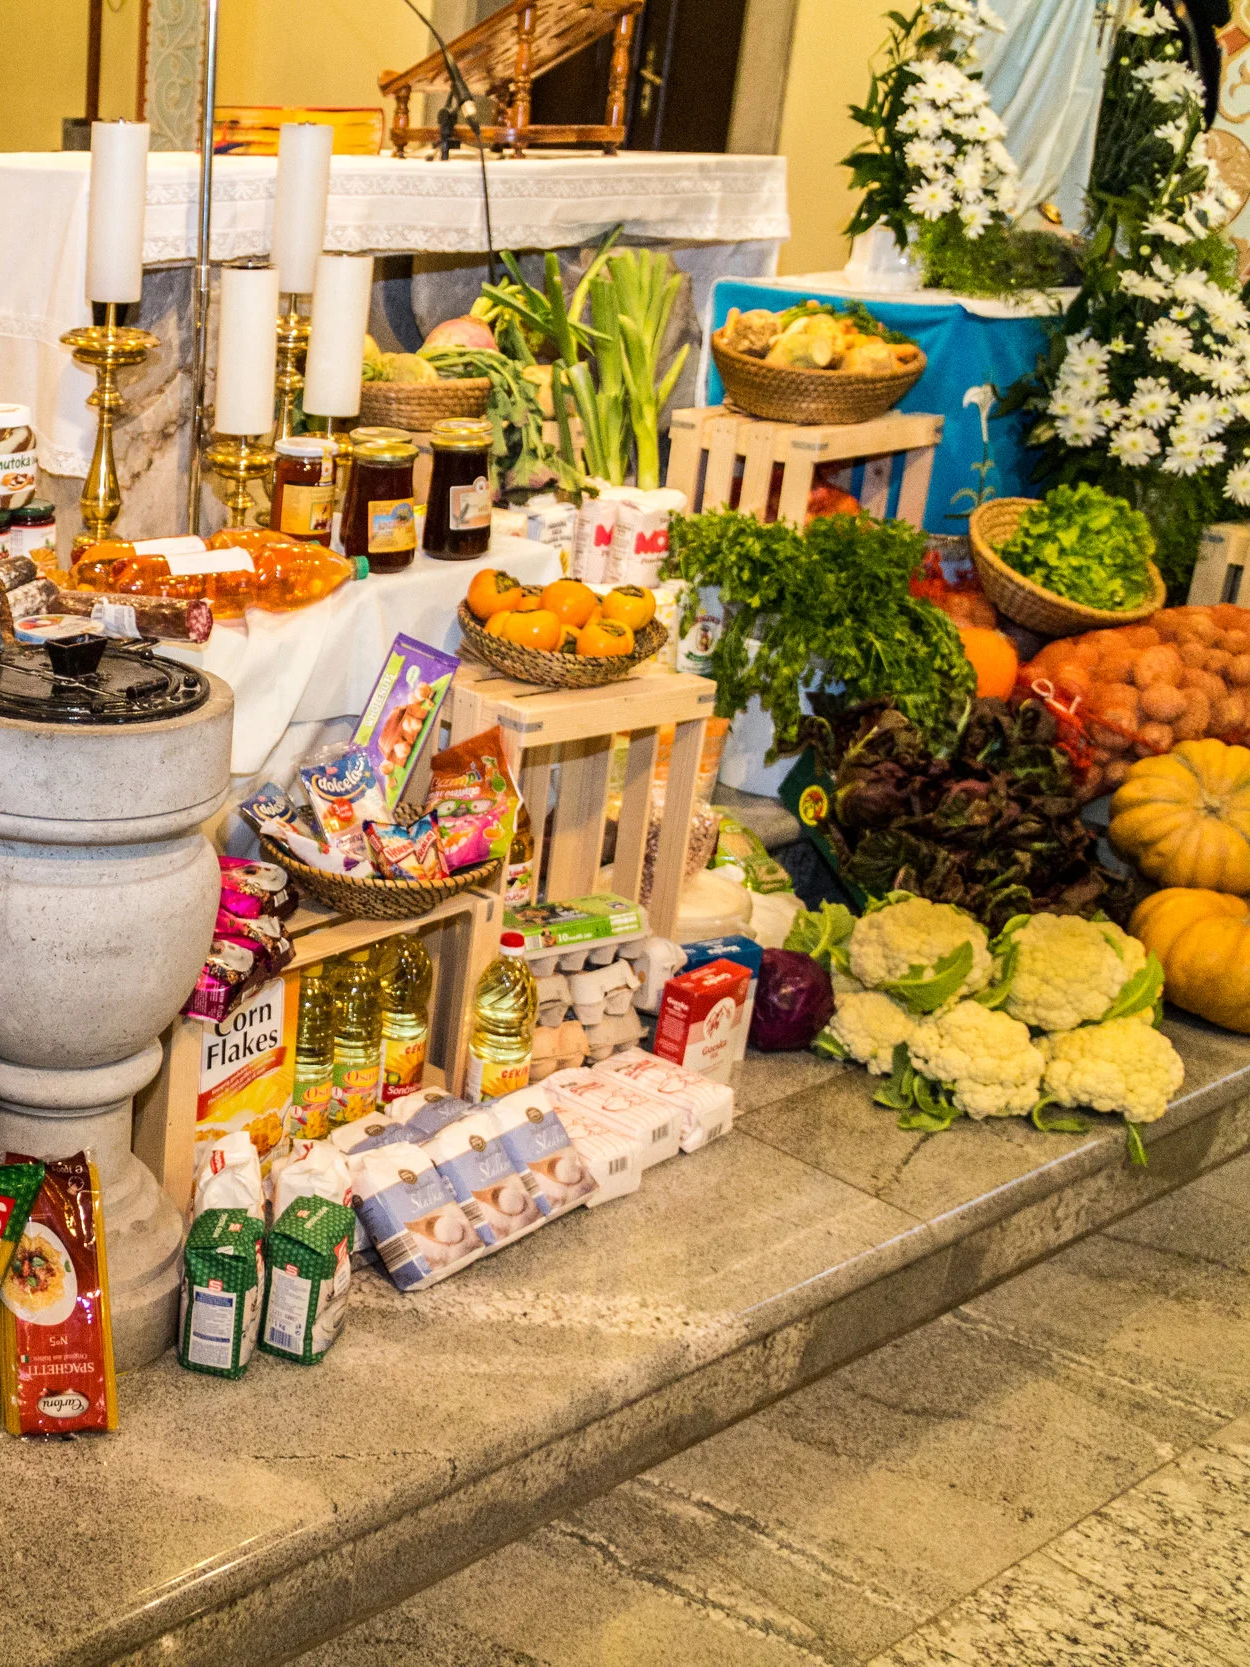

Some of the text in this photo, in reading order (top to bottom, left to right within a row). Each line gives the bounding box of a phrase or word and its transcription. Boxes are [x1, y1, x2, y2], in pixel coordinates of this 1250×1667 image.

[214, 1002, 272, 1037] Corn
[206, 1028, 278, 1070] Flakes
[28, 1361, 95, 1376] SPAGHETTI
[41, 1397, 85, 1413] Carloni
